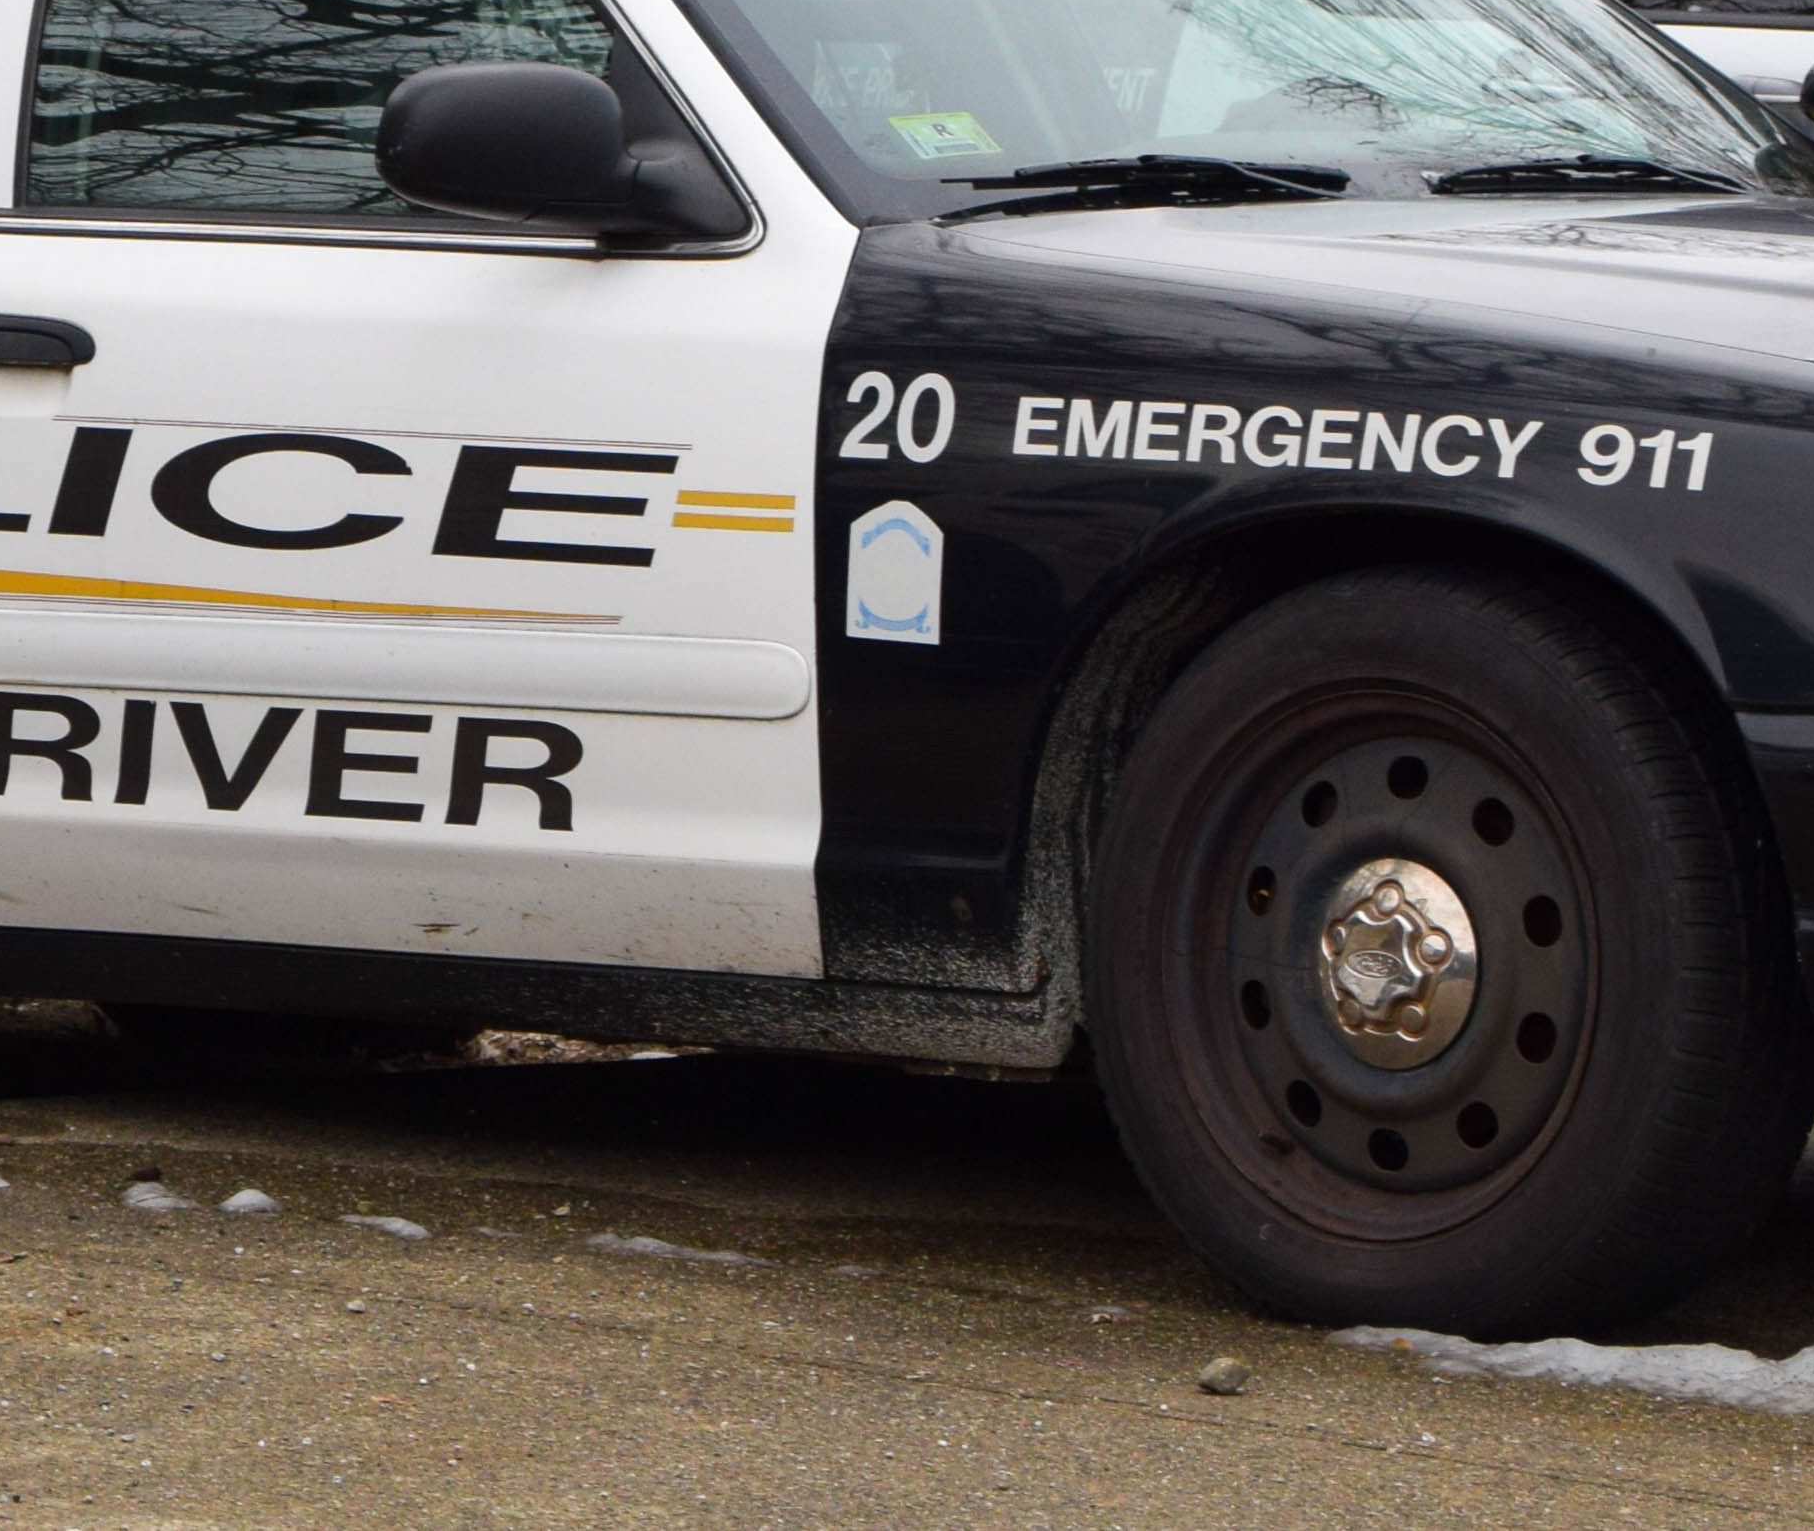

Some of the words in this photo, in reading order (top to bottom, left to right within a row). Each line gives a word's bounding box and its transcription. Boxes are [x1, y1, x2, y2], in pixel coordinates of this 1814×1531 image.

[838, 371, 956, 463] 20
[1012, 396, 1544, 479] EMERGENCY
[1577, 425, 1714, 493] 911
